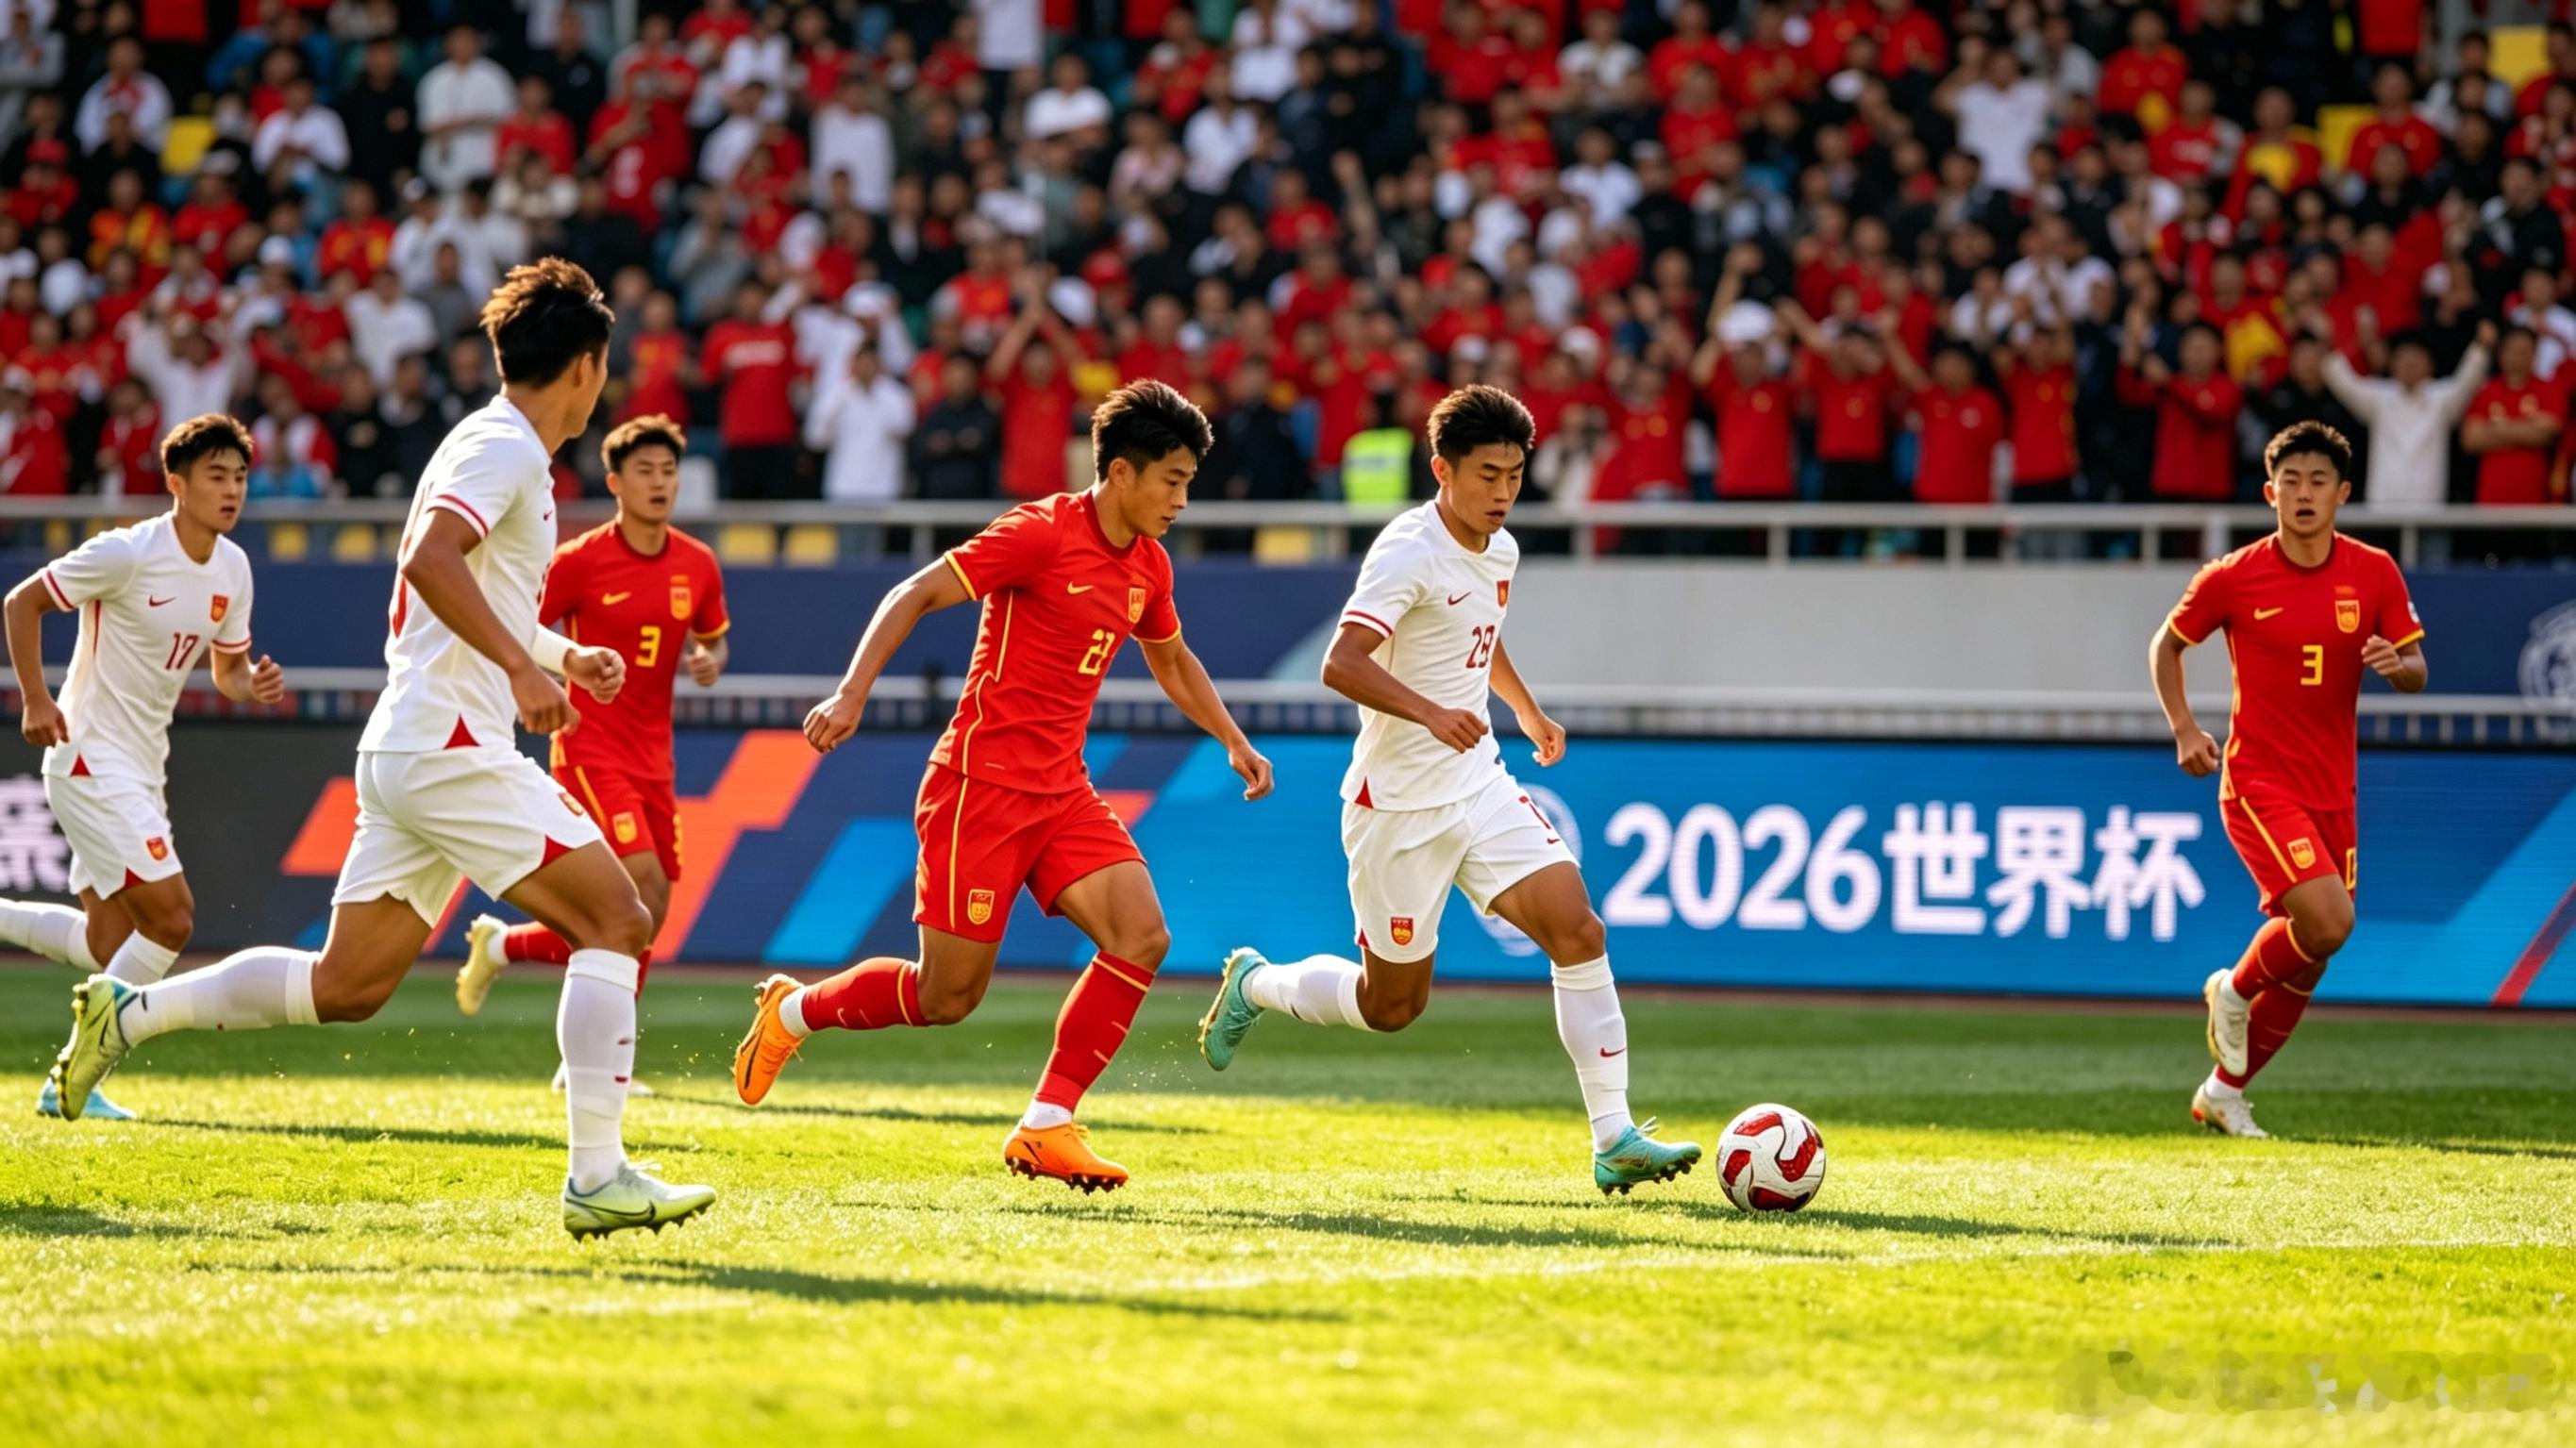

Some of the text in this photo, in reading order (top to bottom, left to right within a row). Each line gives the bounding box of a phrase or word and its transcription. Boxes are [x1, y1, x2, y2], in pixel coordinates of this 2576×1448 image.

[635, 625, 661, 667] 3
[2300, 644, 2323, 686] 3
[1601, 800, 2206, 942] 2026世界杯
